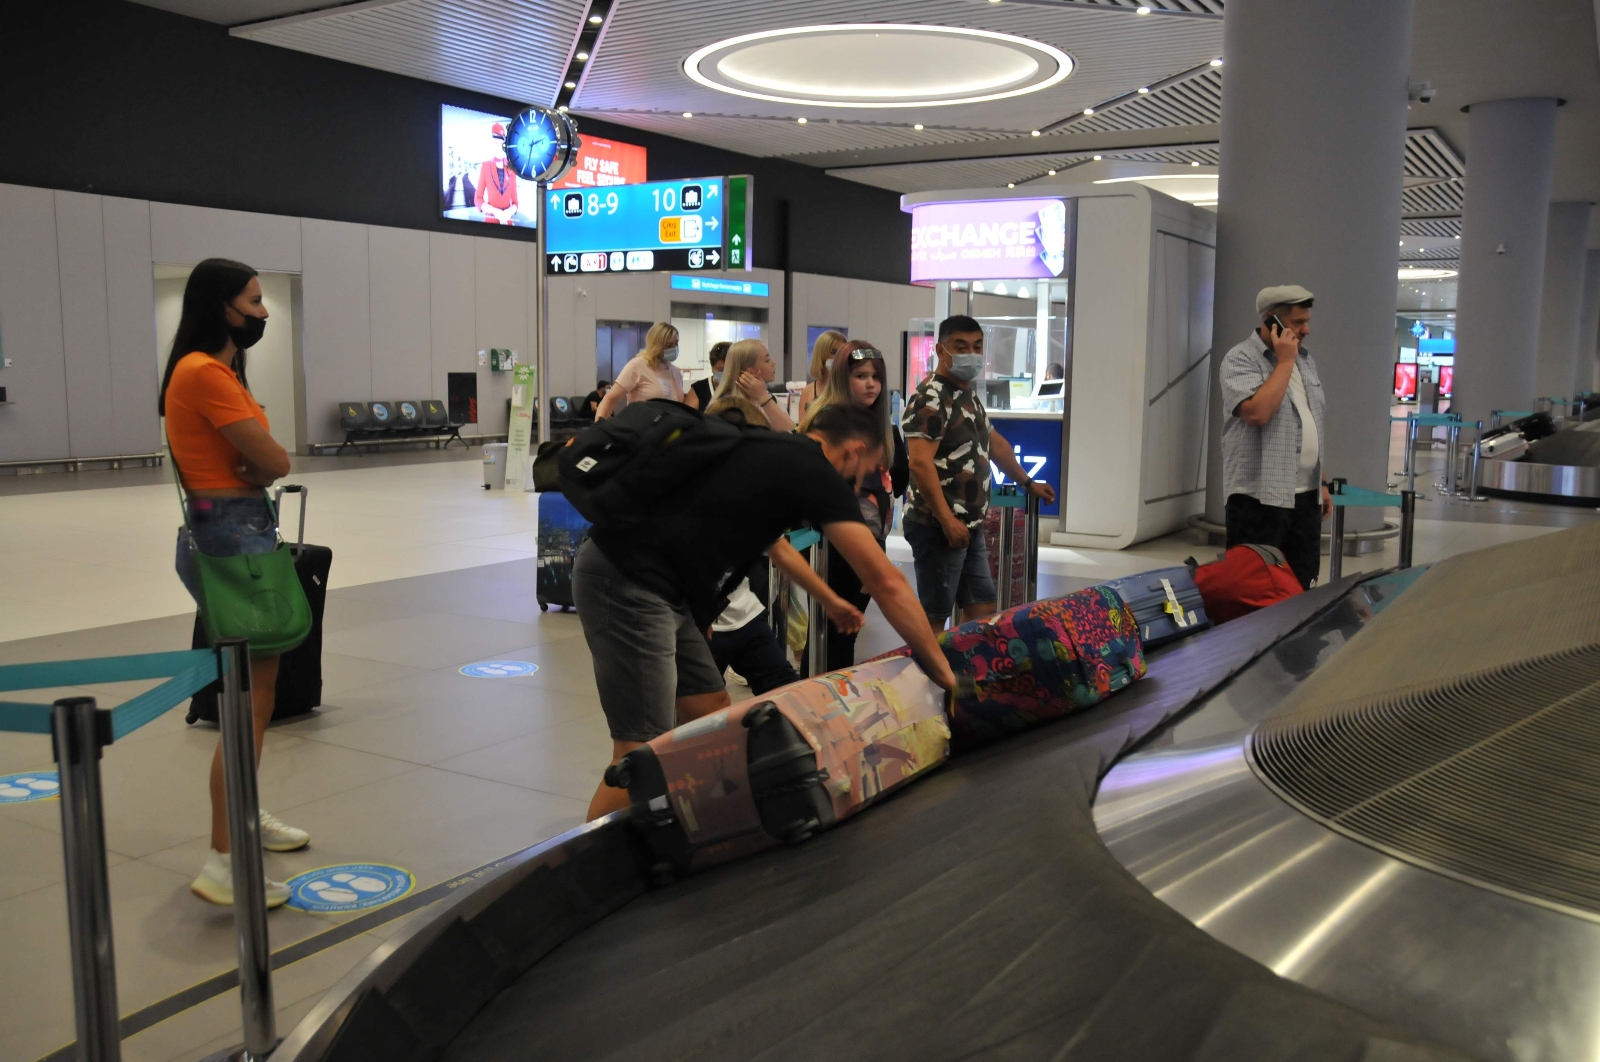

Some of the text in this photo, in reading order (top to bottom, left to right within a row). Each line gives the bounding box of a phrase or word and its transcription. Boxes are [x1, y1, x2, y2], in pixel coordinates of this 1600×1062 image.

[584, 156, 619, 175] FLY SAFE
[577, 169, 596, 186] FEEL
[587, 192, 618, 216] 8-9
[652, 188, 676, 212] 10
[665, 230, 676, 238] Exit
